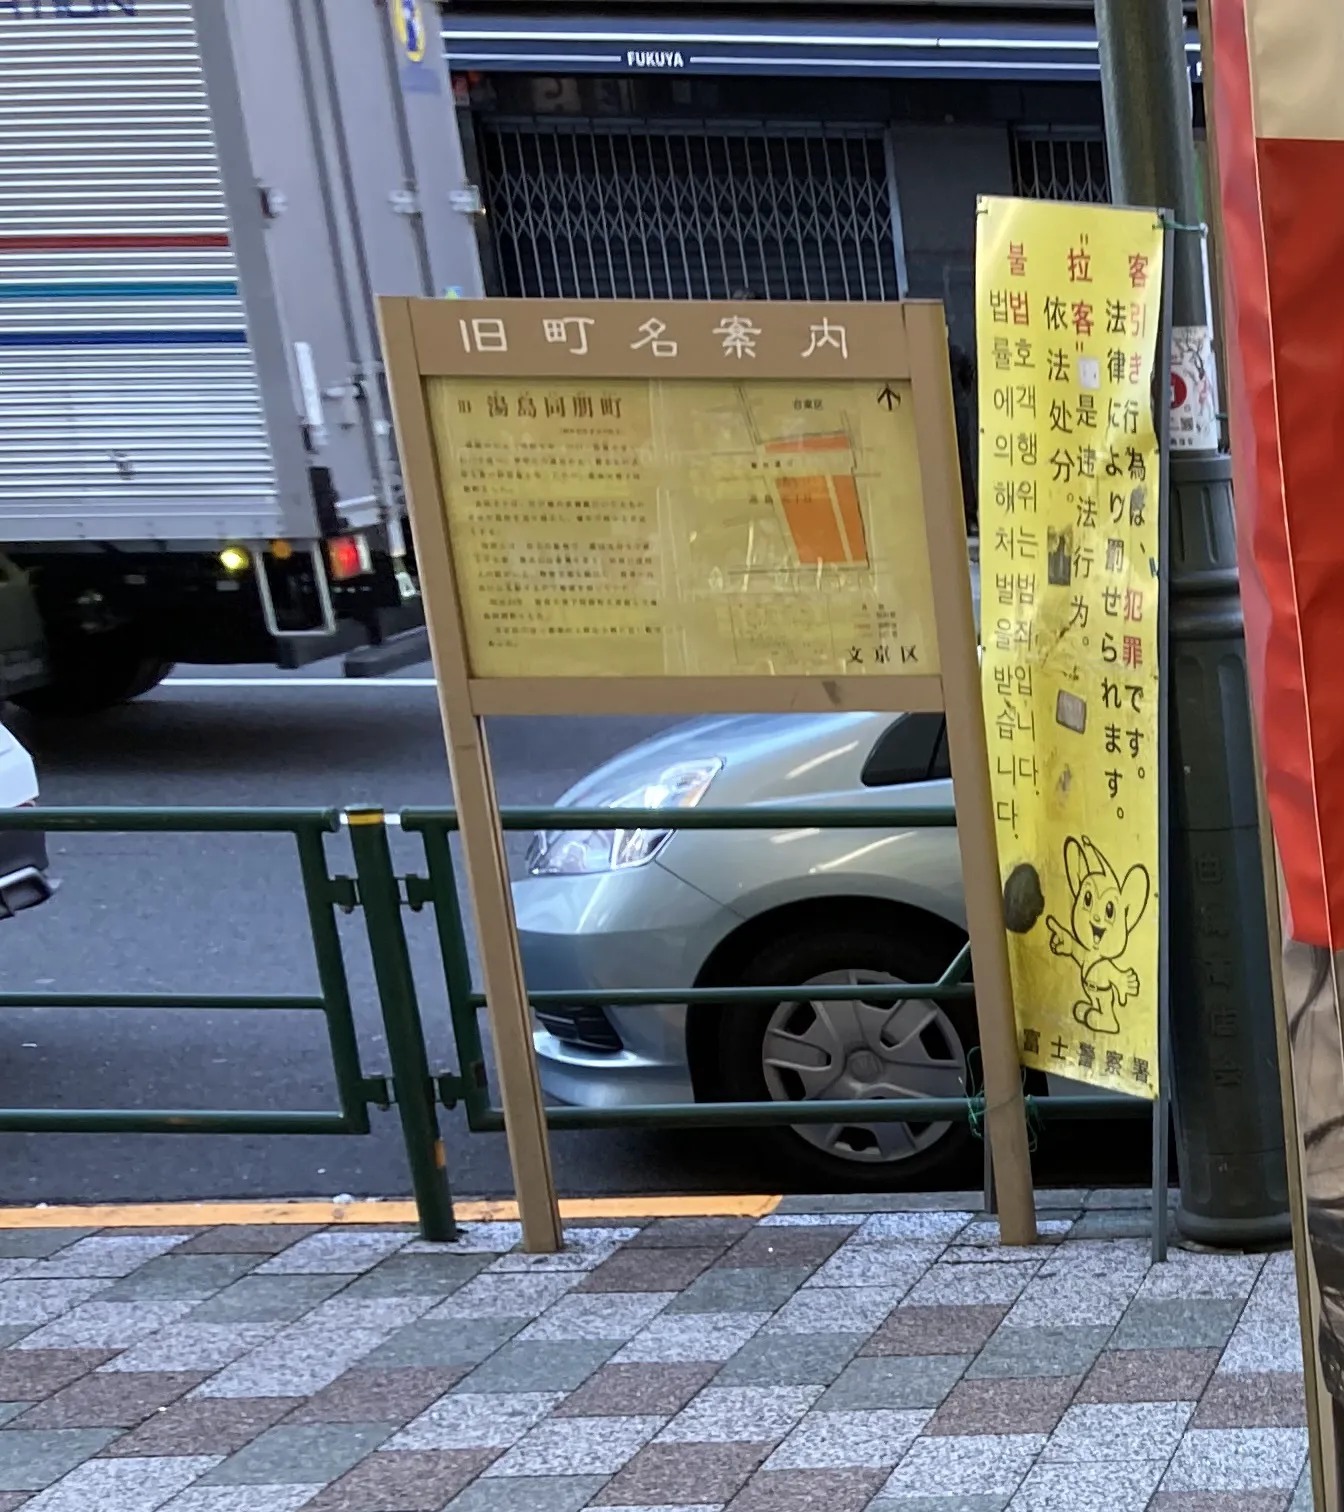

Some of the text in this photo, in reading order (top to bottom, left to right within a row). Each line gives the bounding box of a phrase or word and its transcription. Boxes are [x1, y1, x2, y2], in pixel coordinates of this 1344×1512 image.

[627, 51, 684, 67] FUKUYA
[459, 316, 849, 359] 旧町名案内
[850, 645, 918, 663] 文京区
